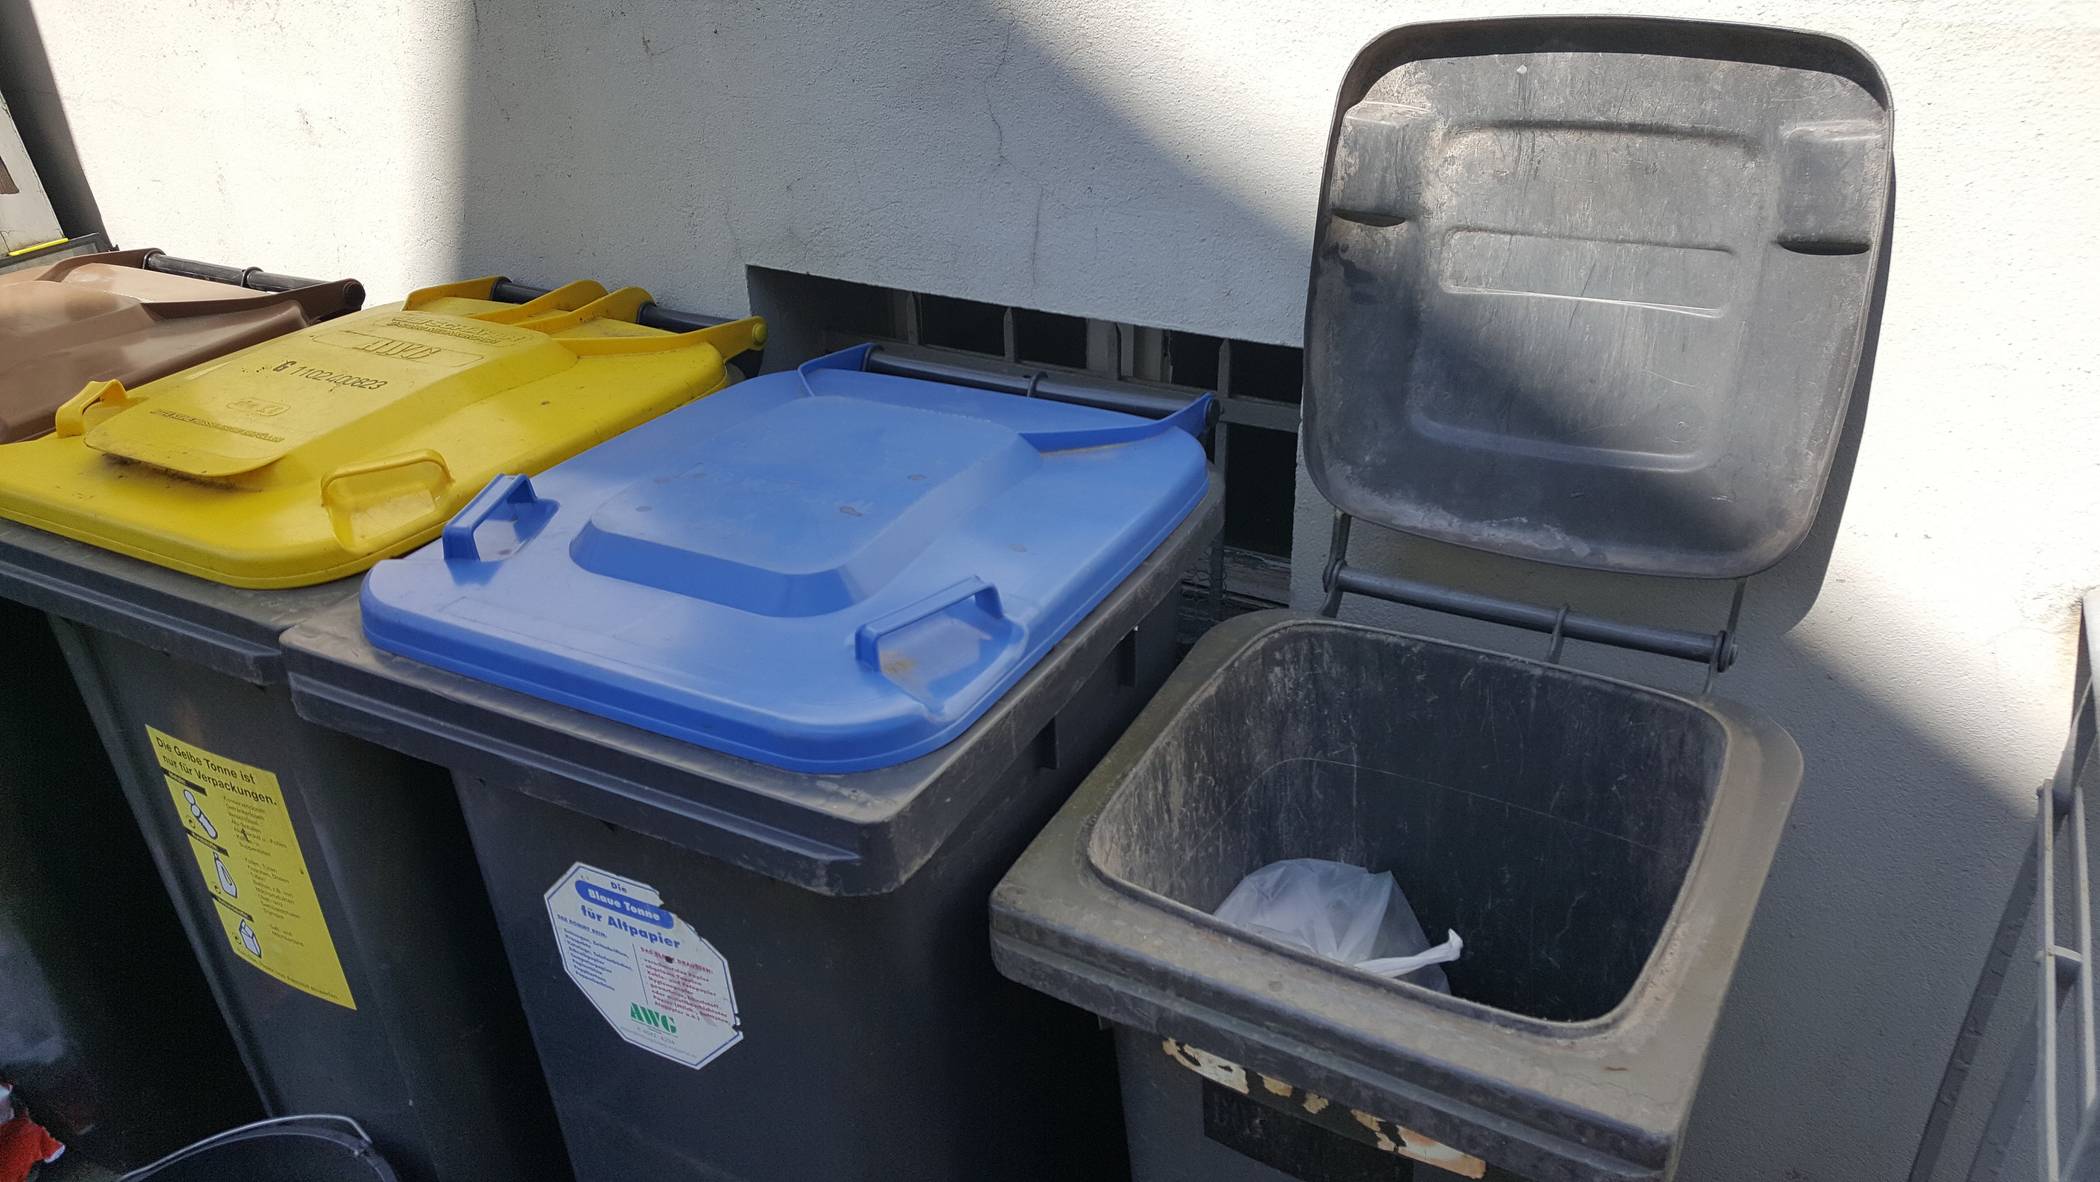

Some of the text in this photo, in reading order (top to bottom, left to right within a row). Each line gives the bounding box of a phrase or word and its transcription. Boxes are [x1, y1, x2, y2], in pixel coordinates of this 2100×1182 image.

[155, 736, 172, 753] Die
[173, 745, 203, 766] Gelbe
[203, 757, 238, 779] Tonne
[239, 770, 256, 785] ist
[162, 755, 178, 768] nur
[178, 761, 193, 776] für
[194, 767, 278, 806] Verpackungen.
[587, 888, 661, 921] Blaue Tonne
[610, 881, 628, 894] Die
[581, 904, 681, 948] für Altpapier
[630, 1002, 678, 1034] AWG
